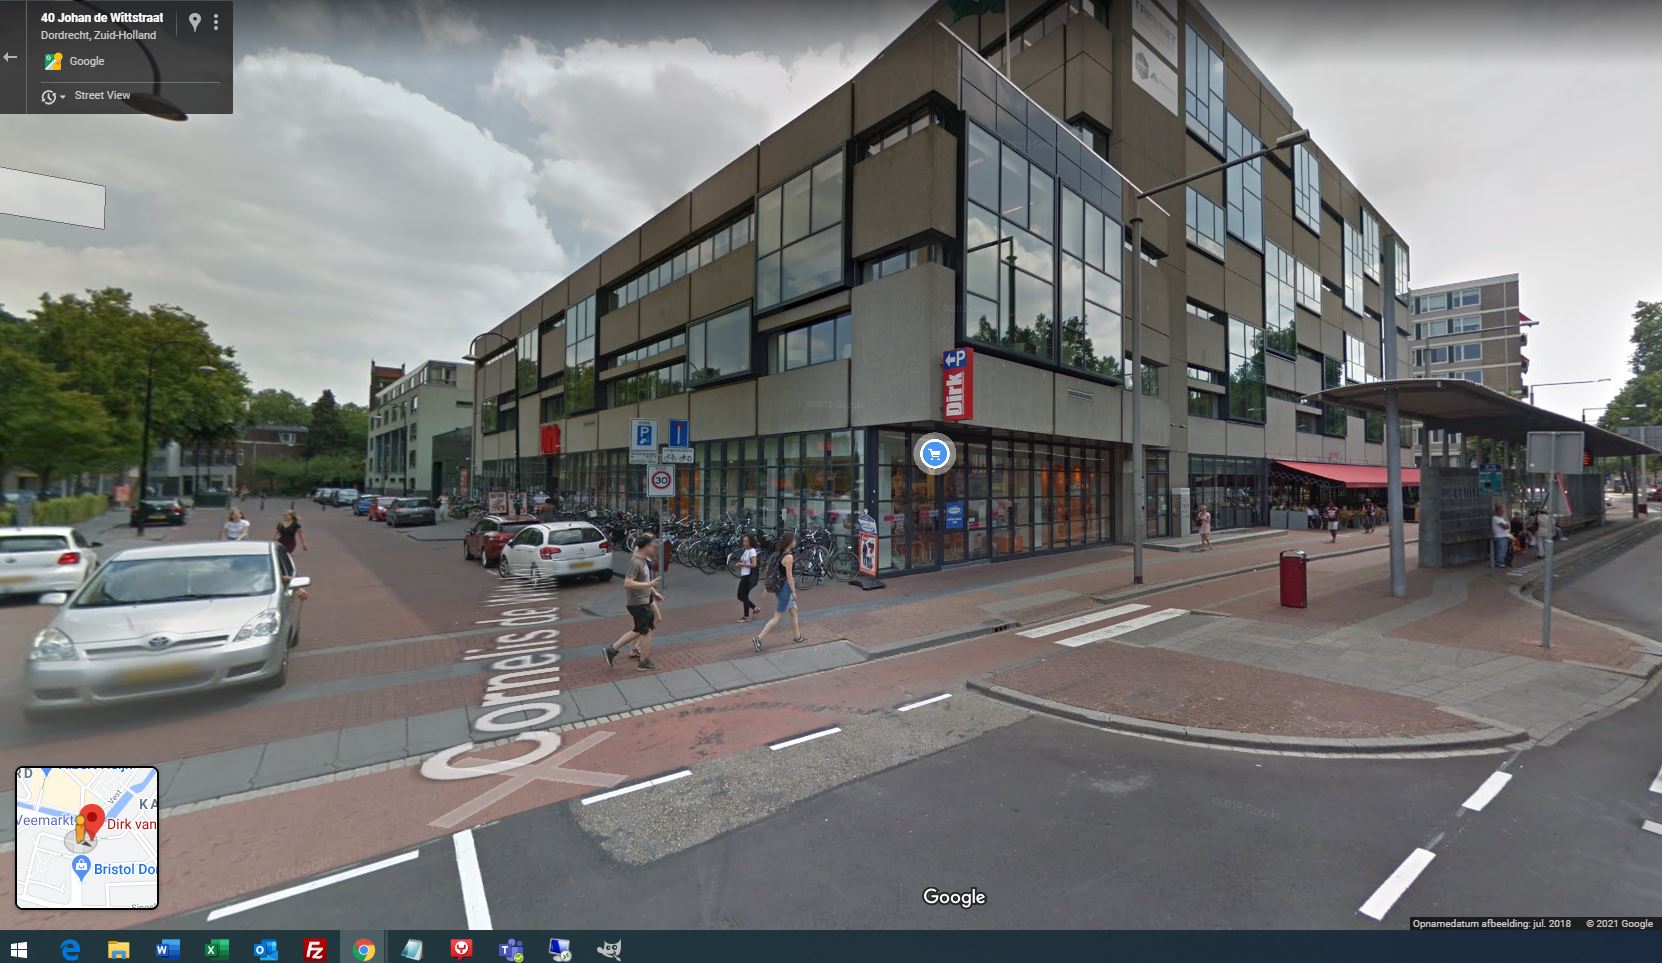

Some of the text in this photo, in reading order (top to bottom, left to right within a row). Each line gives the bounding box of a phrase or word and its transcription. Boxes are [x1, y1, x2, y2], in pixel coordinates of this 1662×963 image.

[956, 350, 966, 367] P
[946, 372, 965, 417] Dirk
[641, 426, 650, 438] P
[655, 476, 668, 485] 30
